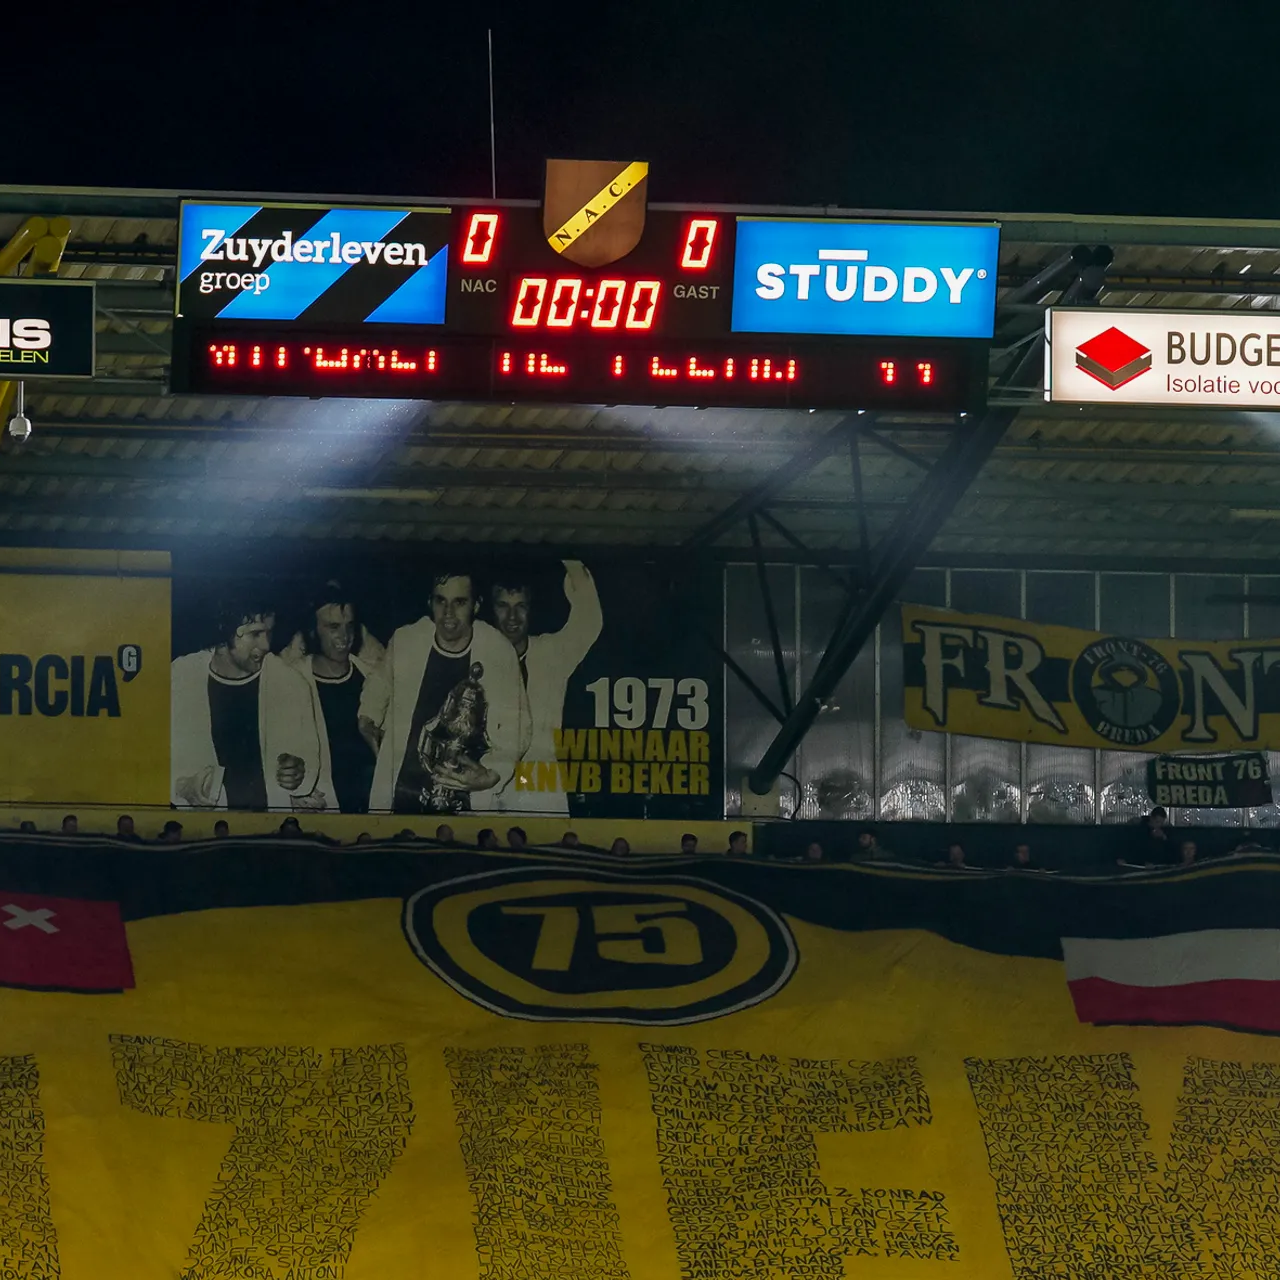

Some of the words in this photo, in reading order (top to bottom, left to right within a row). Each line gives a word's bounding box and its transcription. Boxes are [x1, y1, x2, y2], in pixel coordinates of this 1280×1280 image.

[201, 228, 428, 275] Zuyderleven
[462, 213, 499, 264] 0
[681, 218, 719, 270] 0
[199, 269, 271, 295] groep
[460, 278, 497, 295] NAC
[673, 284, 720, 301] GAST
[512, 277, 661, 329] 00:00
[1165, 374, 1241, 397] Isolatie
[586, 677, 710, 731] 1973
[552, 728, 711, 763] WINNAAR
[515, 761, 603, 795] KNVB
[610, 763, 711, 796] BEKER
[1155, 759, 1223, 781] FRONT
[1234, 759, 1262, 780] 76
[1155, 784, 1228, 805] BREDA
[500, 902, 704, 971] 75
[860, 1188, 945, 1201] KONRAD
